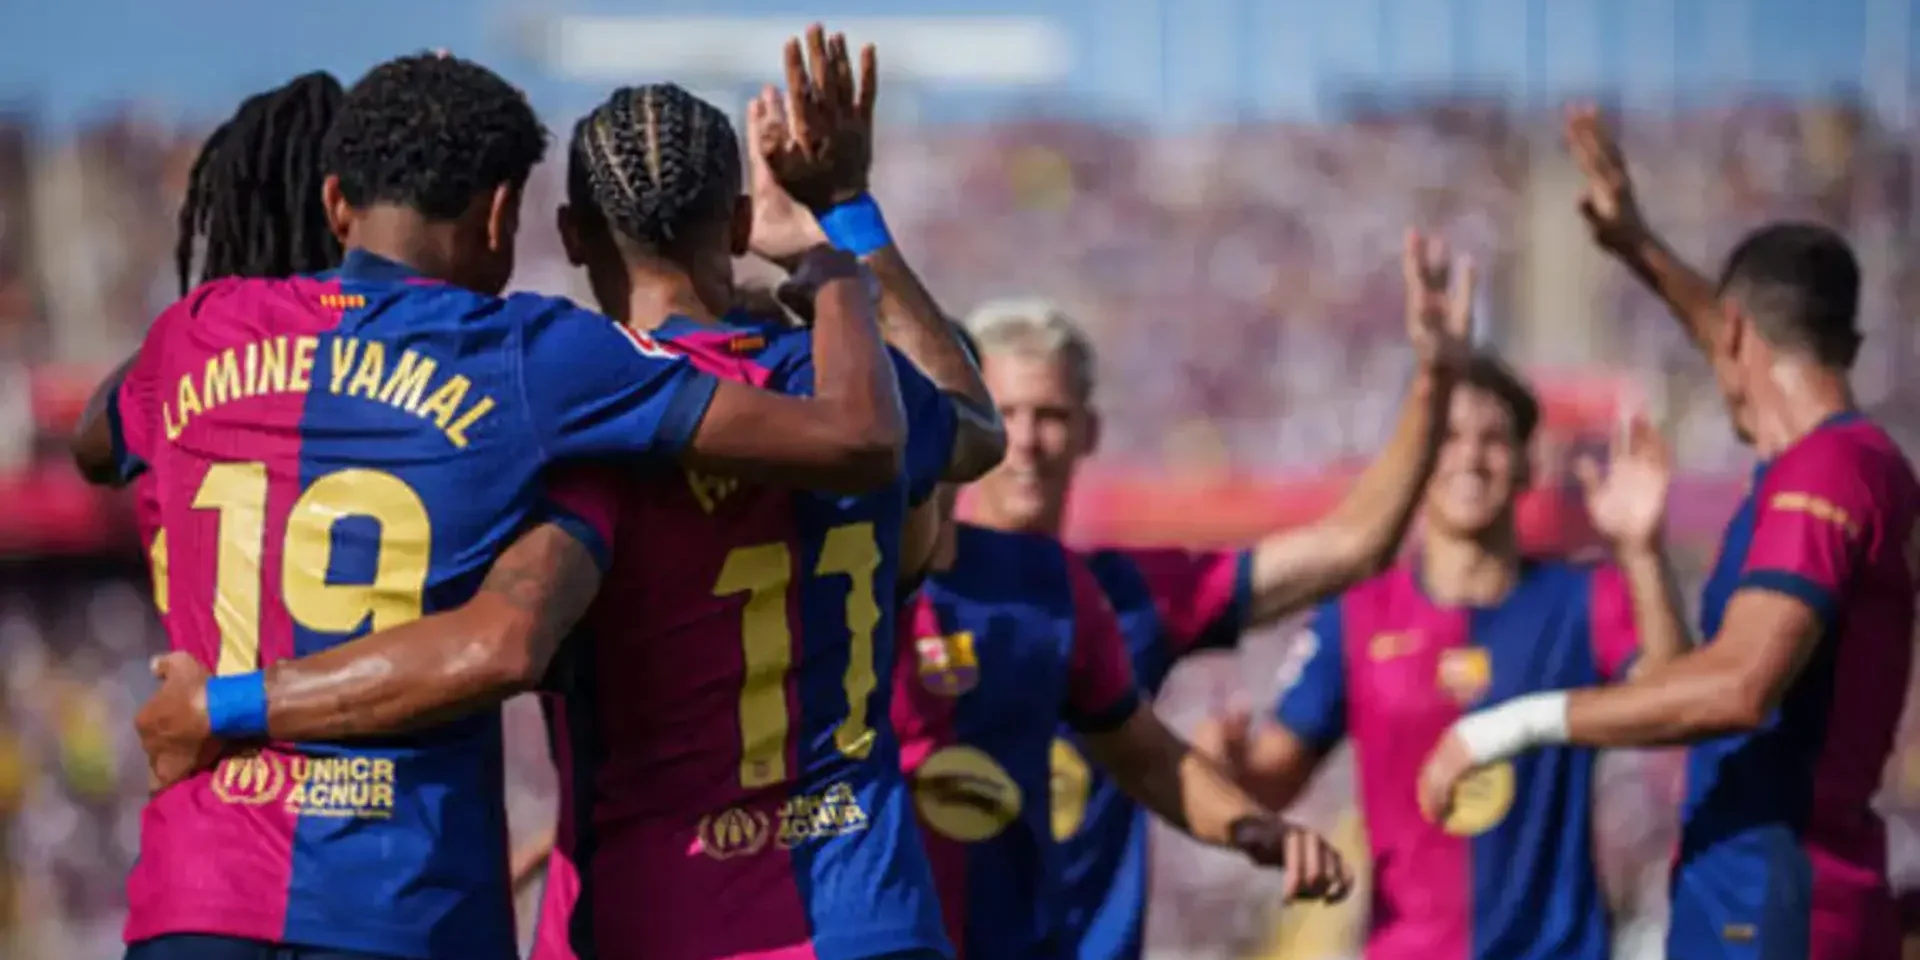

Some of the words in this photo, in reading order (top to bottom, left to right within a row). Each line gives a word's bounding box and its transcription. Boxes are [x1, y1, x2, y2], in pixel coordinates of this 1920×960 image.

[163, 334, 320, 440] LAMINE
[330, 335, 496, 448] YAMAL
[191, 461, 432, 678] 19
[712, 521, 882, 789] 11
[284, 782, 394, 807] ACNUR
[290, 755, 396, 783] UNHCR
